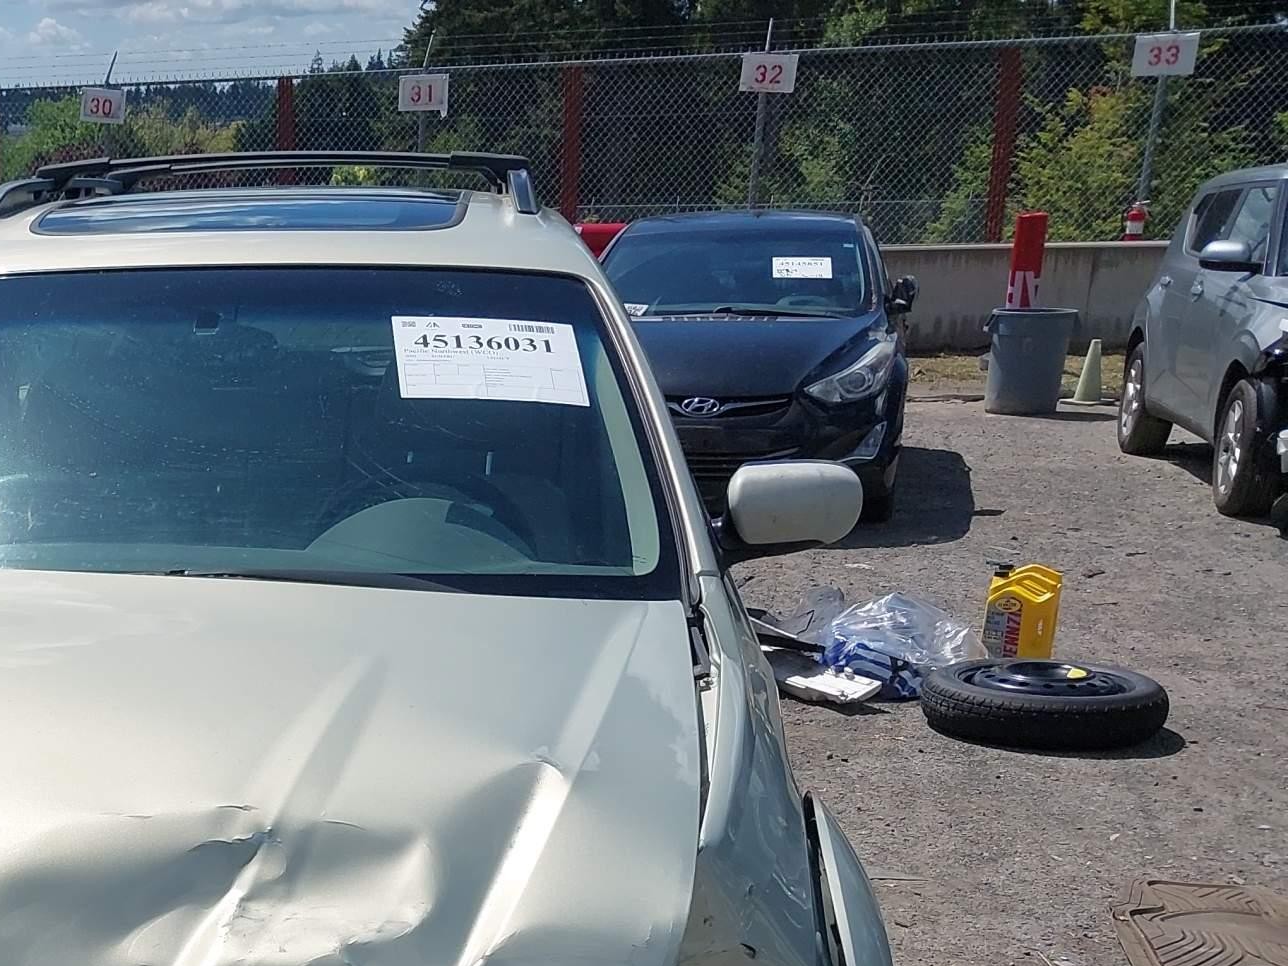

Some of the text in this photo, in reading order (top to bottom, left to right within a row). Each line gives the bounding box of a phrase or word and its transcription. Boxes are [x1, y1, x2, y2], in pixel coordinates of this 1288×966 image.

[1148, 45, 1181, 66] 33
[755, 65, 783, 84] 32
[411, 85, 433, 103] 31
[90, 98, 113, 115] 30
[414, 333, 555, 353] 45136031
